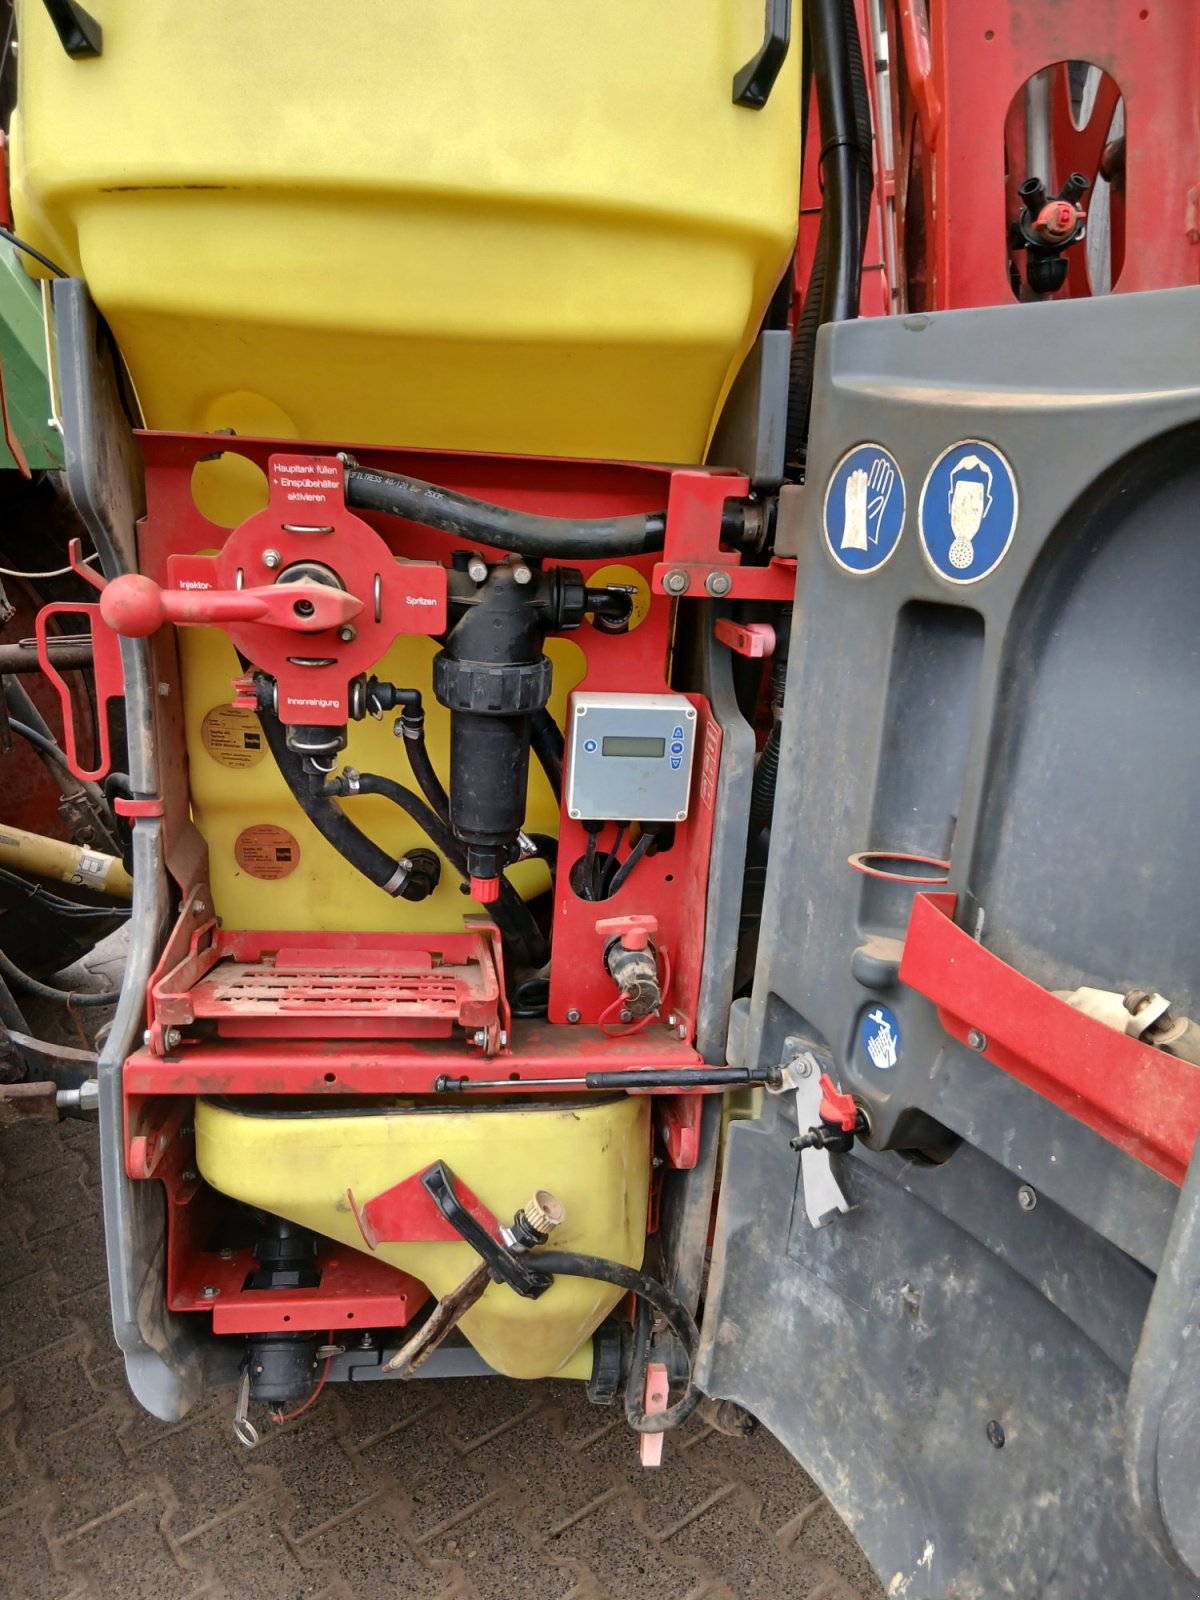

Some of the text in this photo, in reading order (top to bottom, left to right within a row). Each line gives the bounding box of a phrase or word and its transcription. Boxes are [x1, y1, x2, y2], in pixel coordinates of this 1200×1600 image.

[273, 463, 338, 475] Haupttank füllen
[281, 477, 340, 488] Einspülbehälter
[287, 492, 326, 501] aktivieren
[406, 596, 437, 606] Spritzen
[287, 697, 340, 708] Innenreinigung
